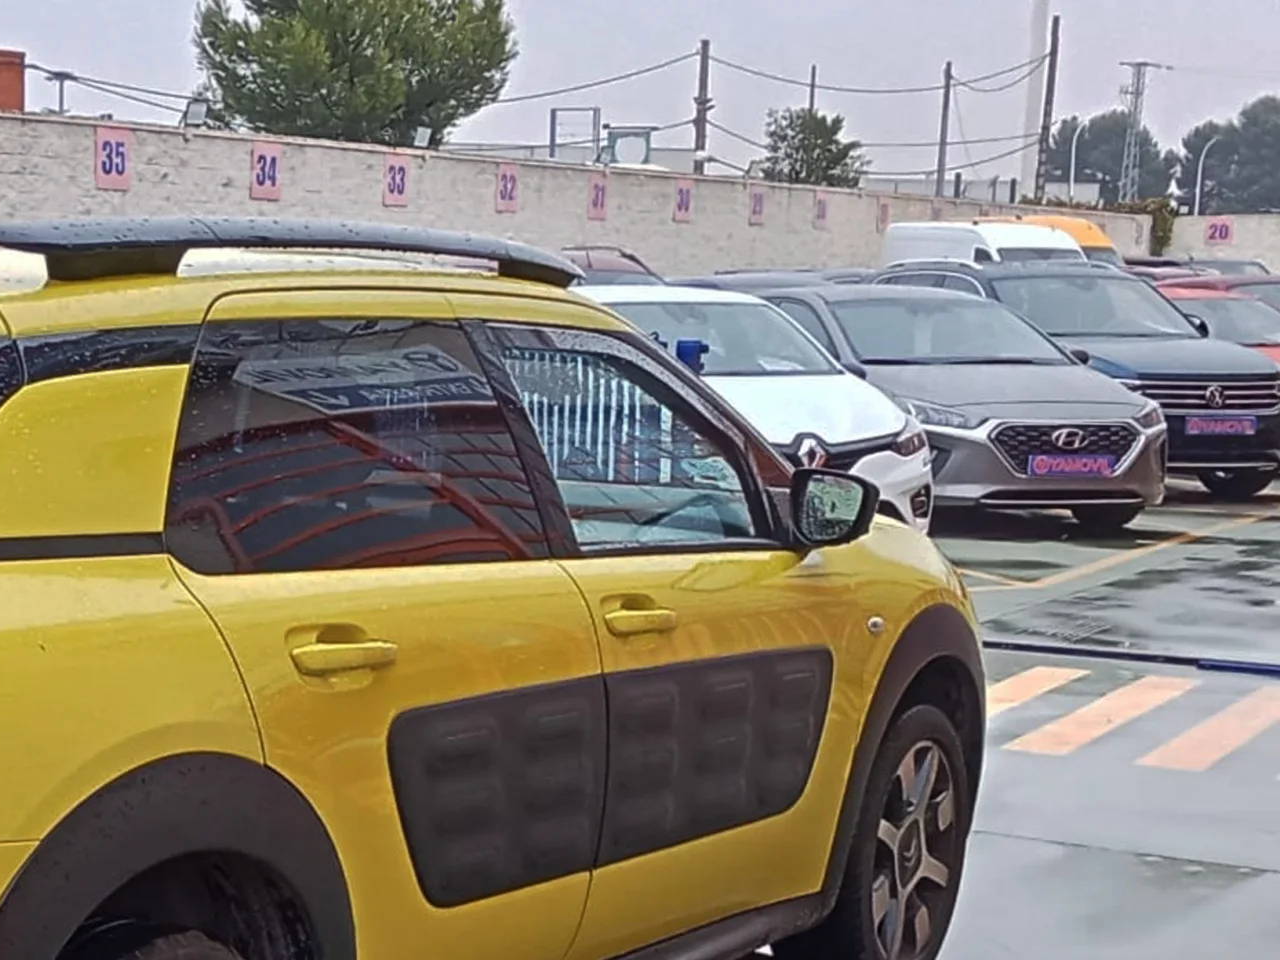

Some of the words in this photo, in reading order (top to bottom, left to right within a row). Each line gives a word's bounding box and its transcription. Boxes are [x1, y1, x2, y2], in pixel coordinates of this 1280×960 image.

[101, 140, 126, 177] 35
[256, 154, 278, 187] 34
[387, 165, 407, 196] 33
[500, 173, 517, 201] 32
[592, 182, 605, 211] 31
[1208, 223, 1229, 240] 20
